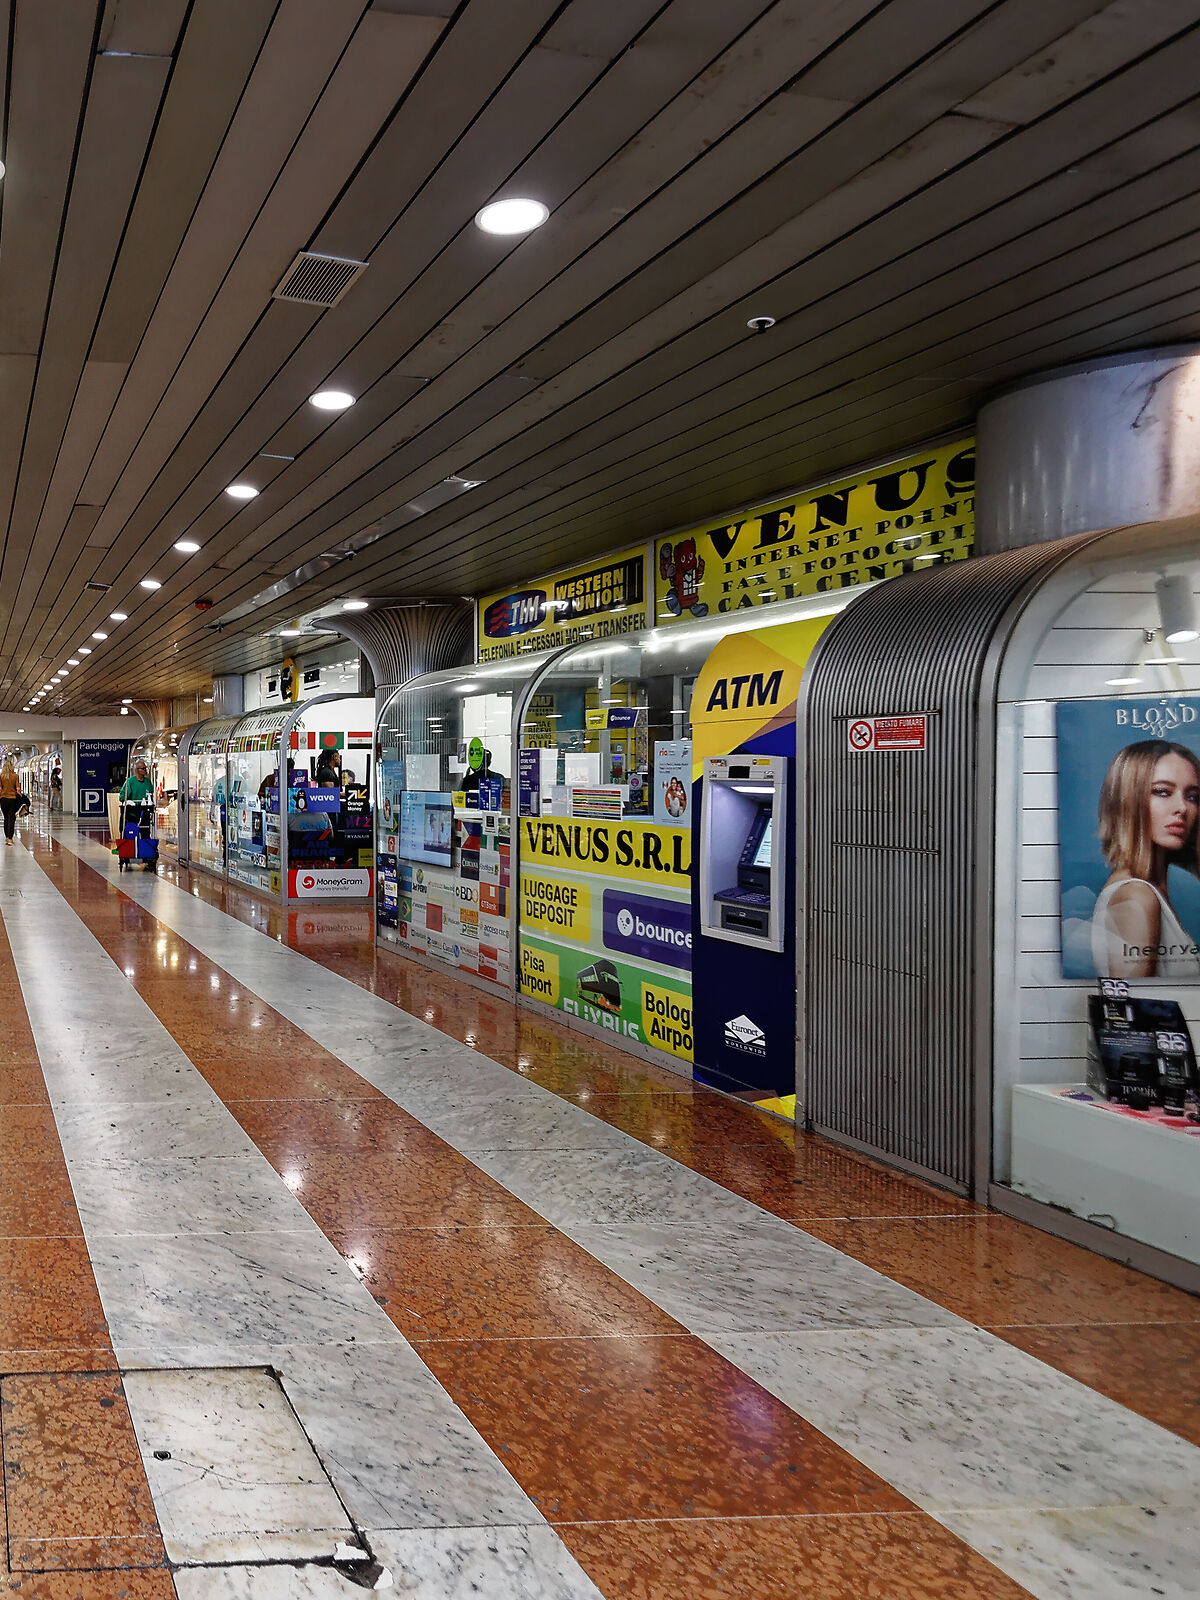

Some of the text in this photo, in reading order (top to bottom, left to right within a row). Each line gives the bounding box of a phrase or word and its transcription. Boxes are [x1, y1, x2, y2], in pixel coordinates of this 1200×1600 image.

[706, 448, 976, 560] VENUS
[721, 521, 975, 593] FAX E FOTOCOPI
[723, 527, 864, 574] INTERNET
[556, 567, 624, 600] WESTERN
[718, 583, 802, 613] CALL
[511, 595, 540, 626] TIM
[576, 585, 624, 613] UNION
[480, 612, 647, 662] TELEFONIA E ACCESSORI MONEY TRANSFER
[706, 670, 784, 712] ATM
[875, 718, 924, 728] VIETATO FUMARE
[1116, 706, 1196, 725] BLOND
[79, 741, 125, 751] Parcheggio
[84, 791, 100, 811] P
[309, 794, 335, 802] wave
[526, 821, 692, 876] VENUS S.R.L
[316, 878, 363, 886] MoneyGram
[460, 885, 479, 903] BDO
[524, 878, 578, 907] LUGGAGE
[526, 899, 575, 928] DEPOSIT
[635, 916, 692, 949] bounce
[523, 950, 545, 973] Pisa
[519, 967, 553, 997] Airport
[645, 990, 693, 1030] Bolog
[650, 1017, 693, 1051] Airpo
[731, 1021, 759, 1037] Euronet
[725, 1039, 766, 1056] WORLDWIDE
